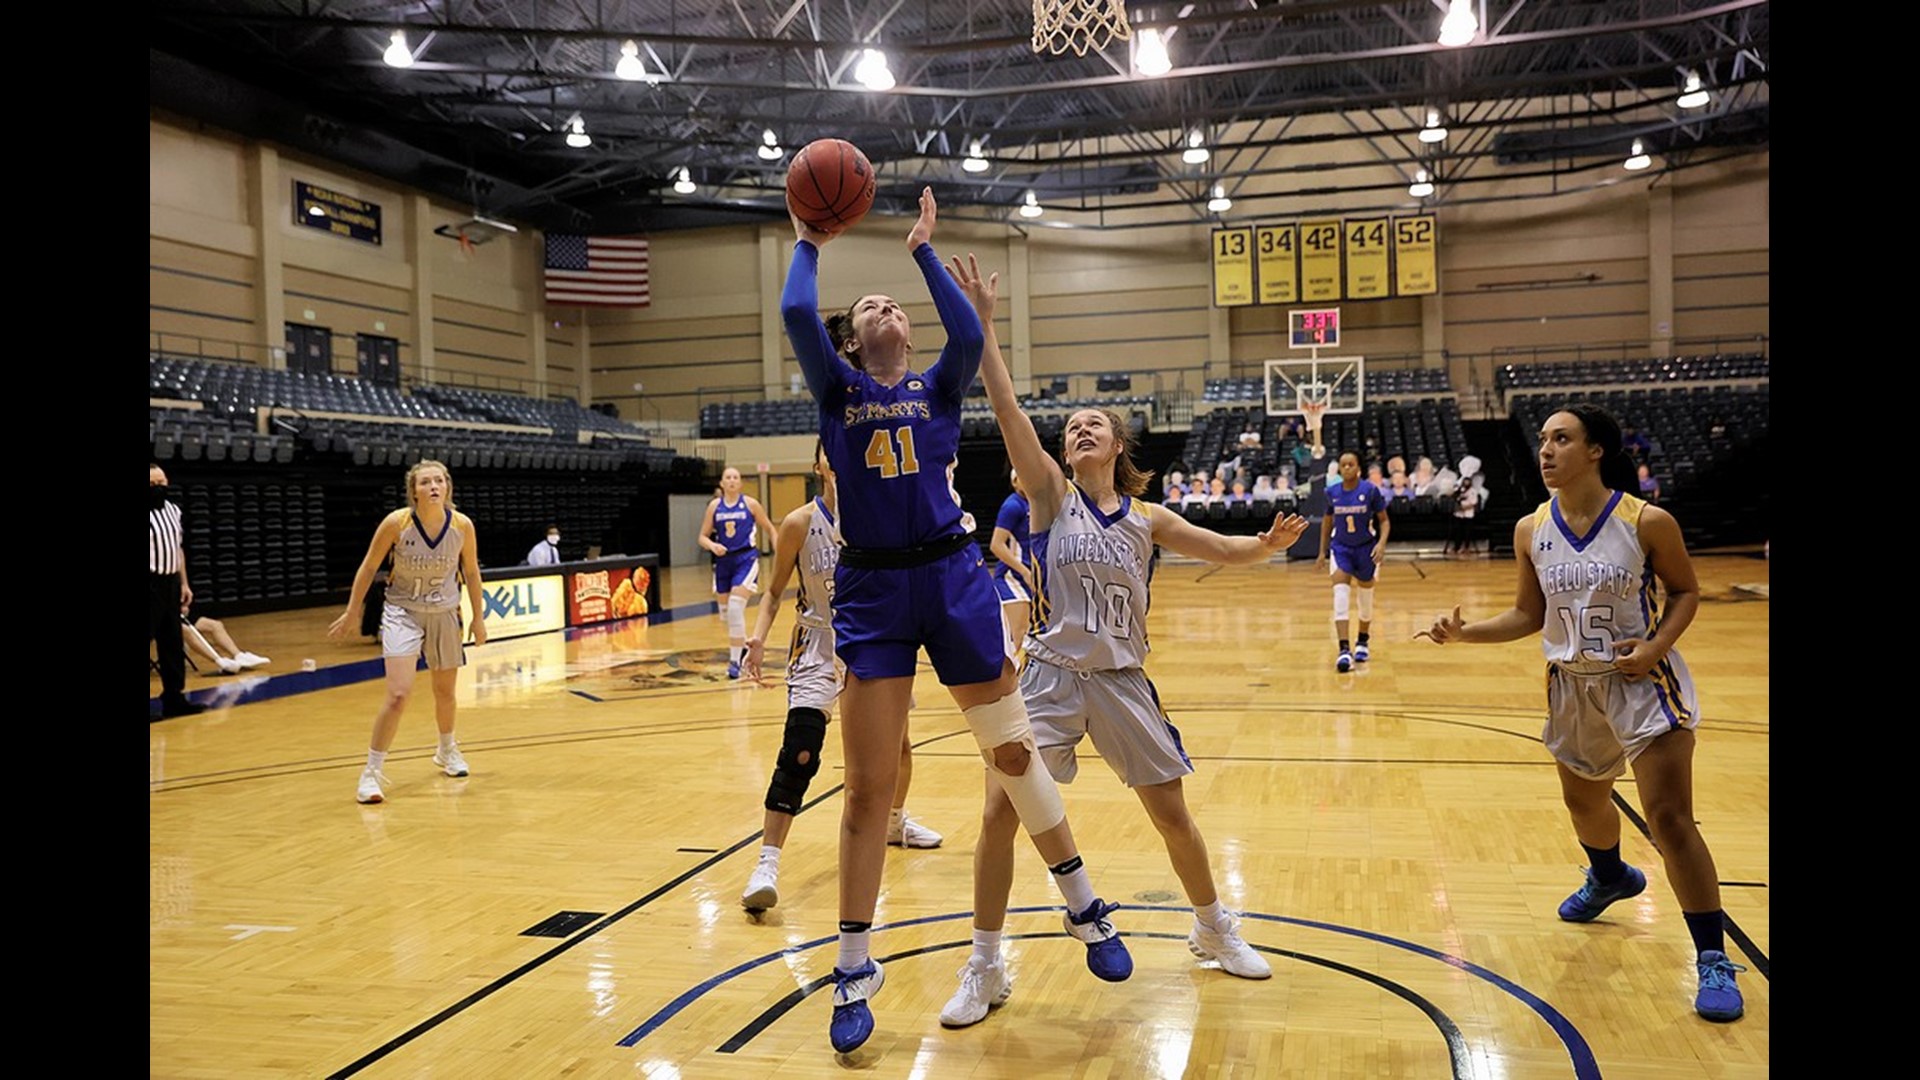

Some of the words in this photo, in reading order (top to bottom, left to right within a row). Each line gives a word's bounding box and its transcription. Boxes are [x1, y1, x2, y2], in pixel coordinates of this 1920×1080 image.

[1220, 232, 1245, 256] 13
[1261, 229, 1292, 253] 34
[1305, 226, 1336, 250] 42
[1350, 223, 1384, 248] 44
[1398, 220, 1431, 244] 52
[1314, 328, 1325, 344] 4
[864, 425, 920, 479] 41
[1345, 514, 1356, 533] 1
[1080, 575, 1133, 641] 10
[1557, 605, 1616, 664] 15
